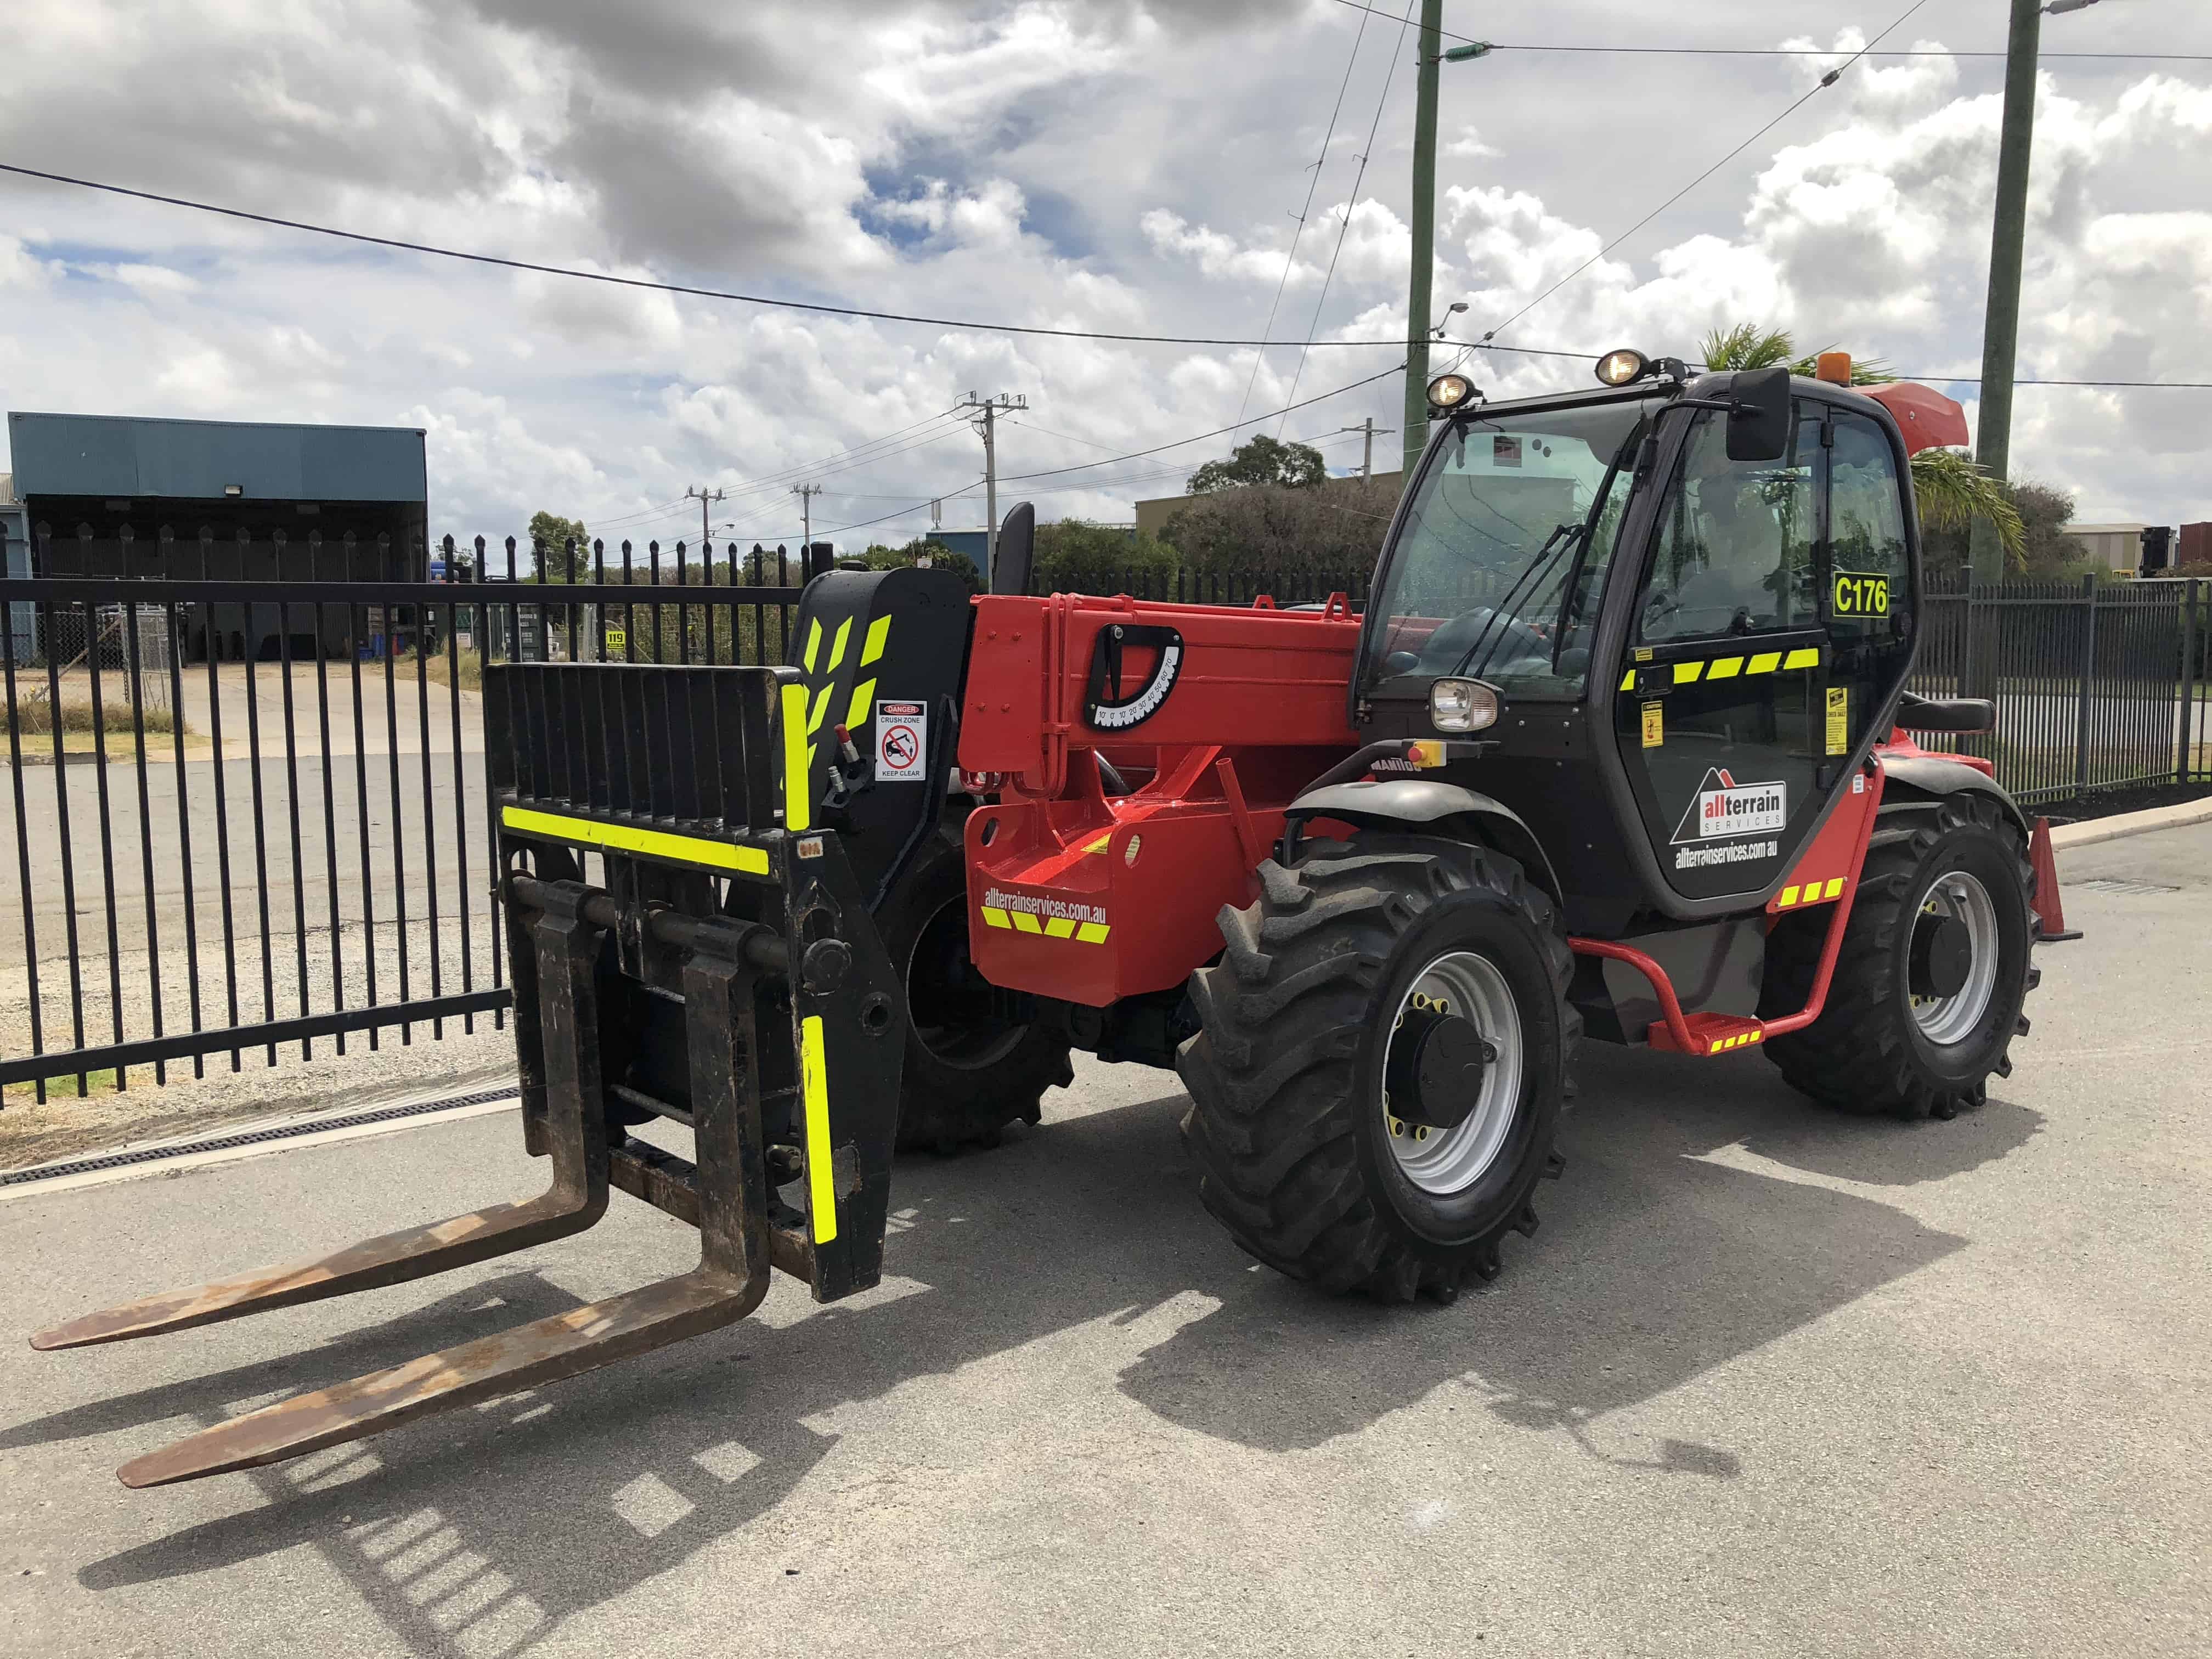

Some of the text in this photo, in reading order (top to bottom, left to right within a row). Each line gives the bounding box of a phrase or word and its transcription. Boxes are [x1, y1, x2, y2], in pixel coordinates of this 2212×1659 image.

[1836, 577, 1887, 613] C176
[609, 634, 623, 642] 119
[1705, 789, 1780, 818] allterrain
[1705, 815, 1780, 832] SERVICES
[985, 887, 1106, 924] allterrainservices.com.au
